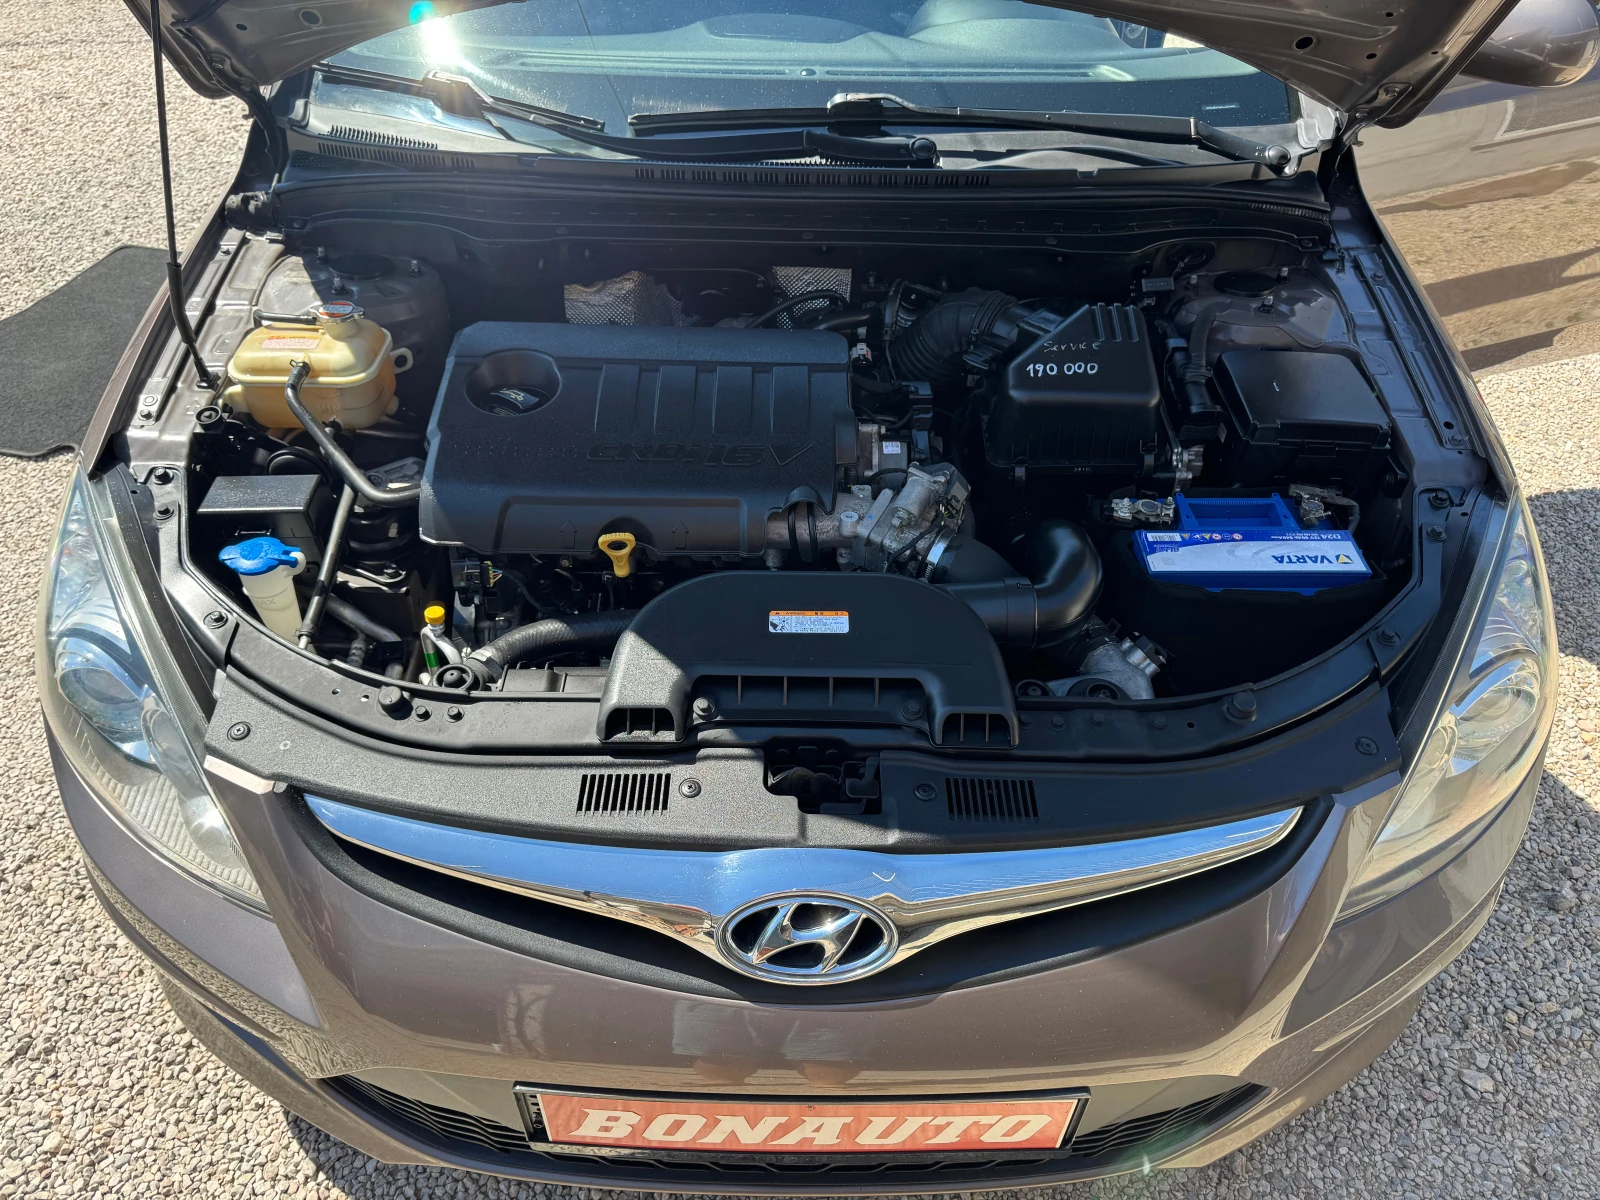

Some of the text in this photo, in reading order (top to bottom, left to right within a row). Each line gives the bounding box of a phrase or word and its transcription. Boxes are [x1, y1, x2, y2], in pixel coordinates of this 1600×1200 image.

[1026, 361, 1099, 378] 190 000
[1271, 554, 1334, 564] VARTA
[566, 1108, 1053, 1145] BONAUTO
